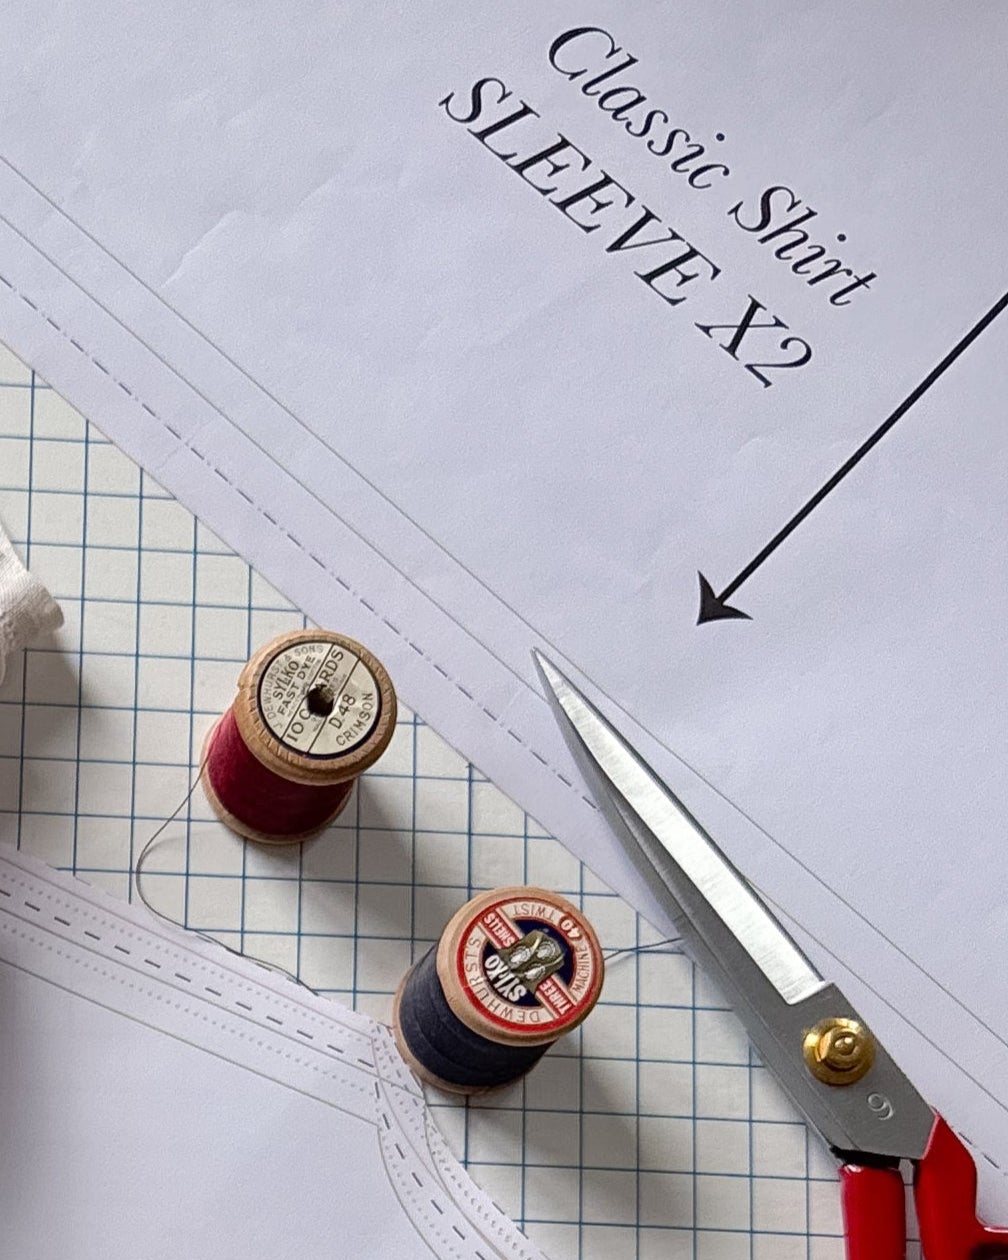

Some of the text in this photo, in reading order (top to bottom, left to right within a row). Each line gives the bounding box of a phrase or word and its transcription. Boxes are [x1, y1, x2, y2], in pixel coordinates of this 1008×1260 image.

[548, 26, 878, 307] Classic Shirt
[438, 76, 814, 389] SLEEVE X2
[272, 659, 300, 700] SYLKO
[276, 682, 300, 716] FAST
[296, 655, 316, 680] DYE
[335, 692, 373, 746] CRIMSON
[483, 912, 571, 1015] THREE SHELLS
[484, 954, 527, 1001] SYLKO
[513, 903, 592, 993] MACHINE 40 TWIST
